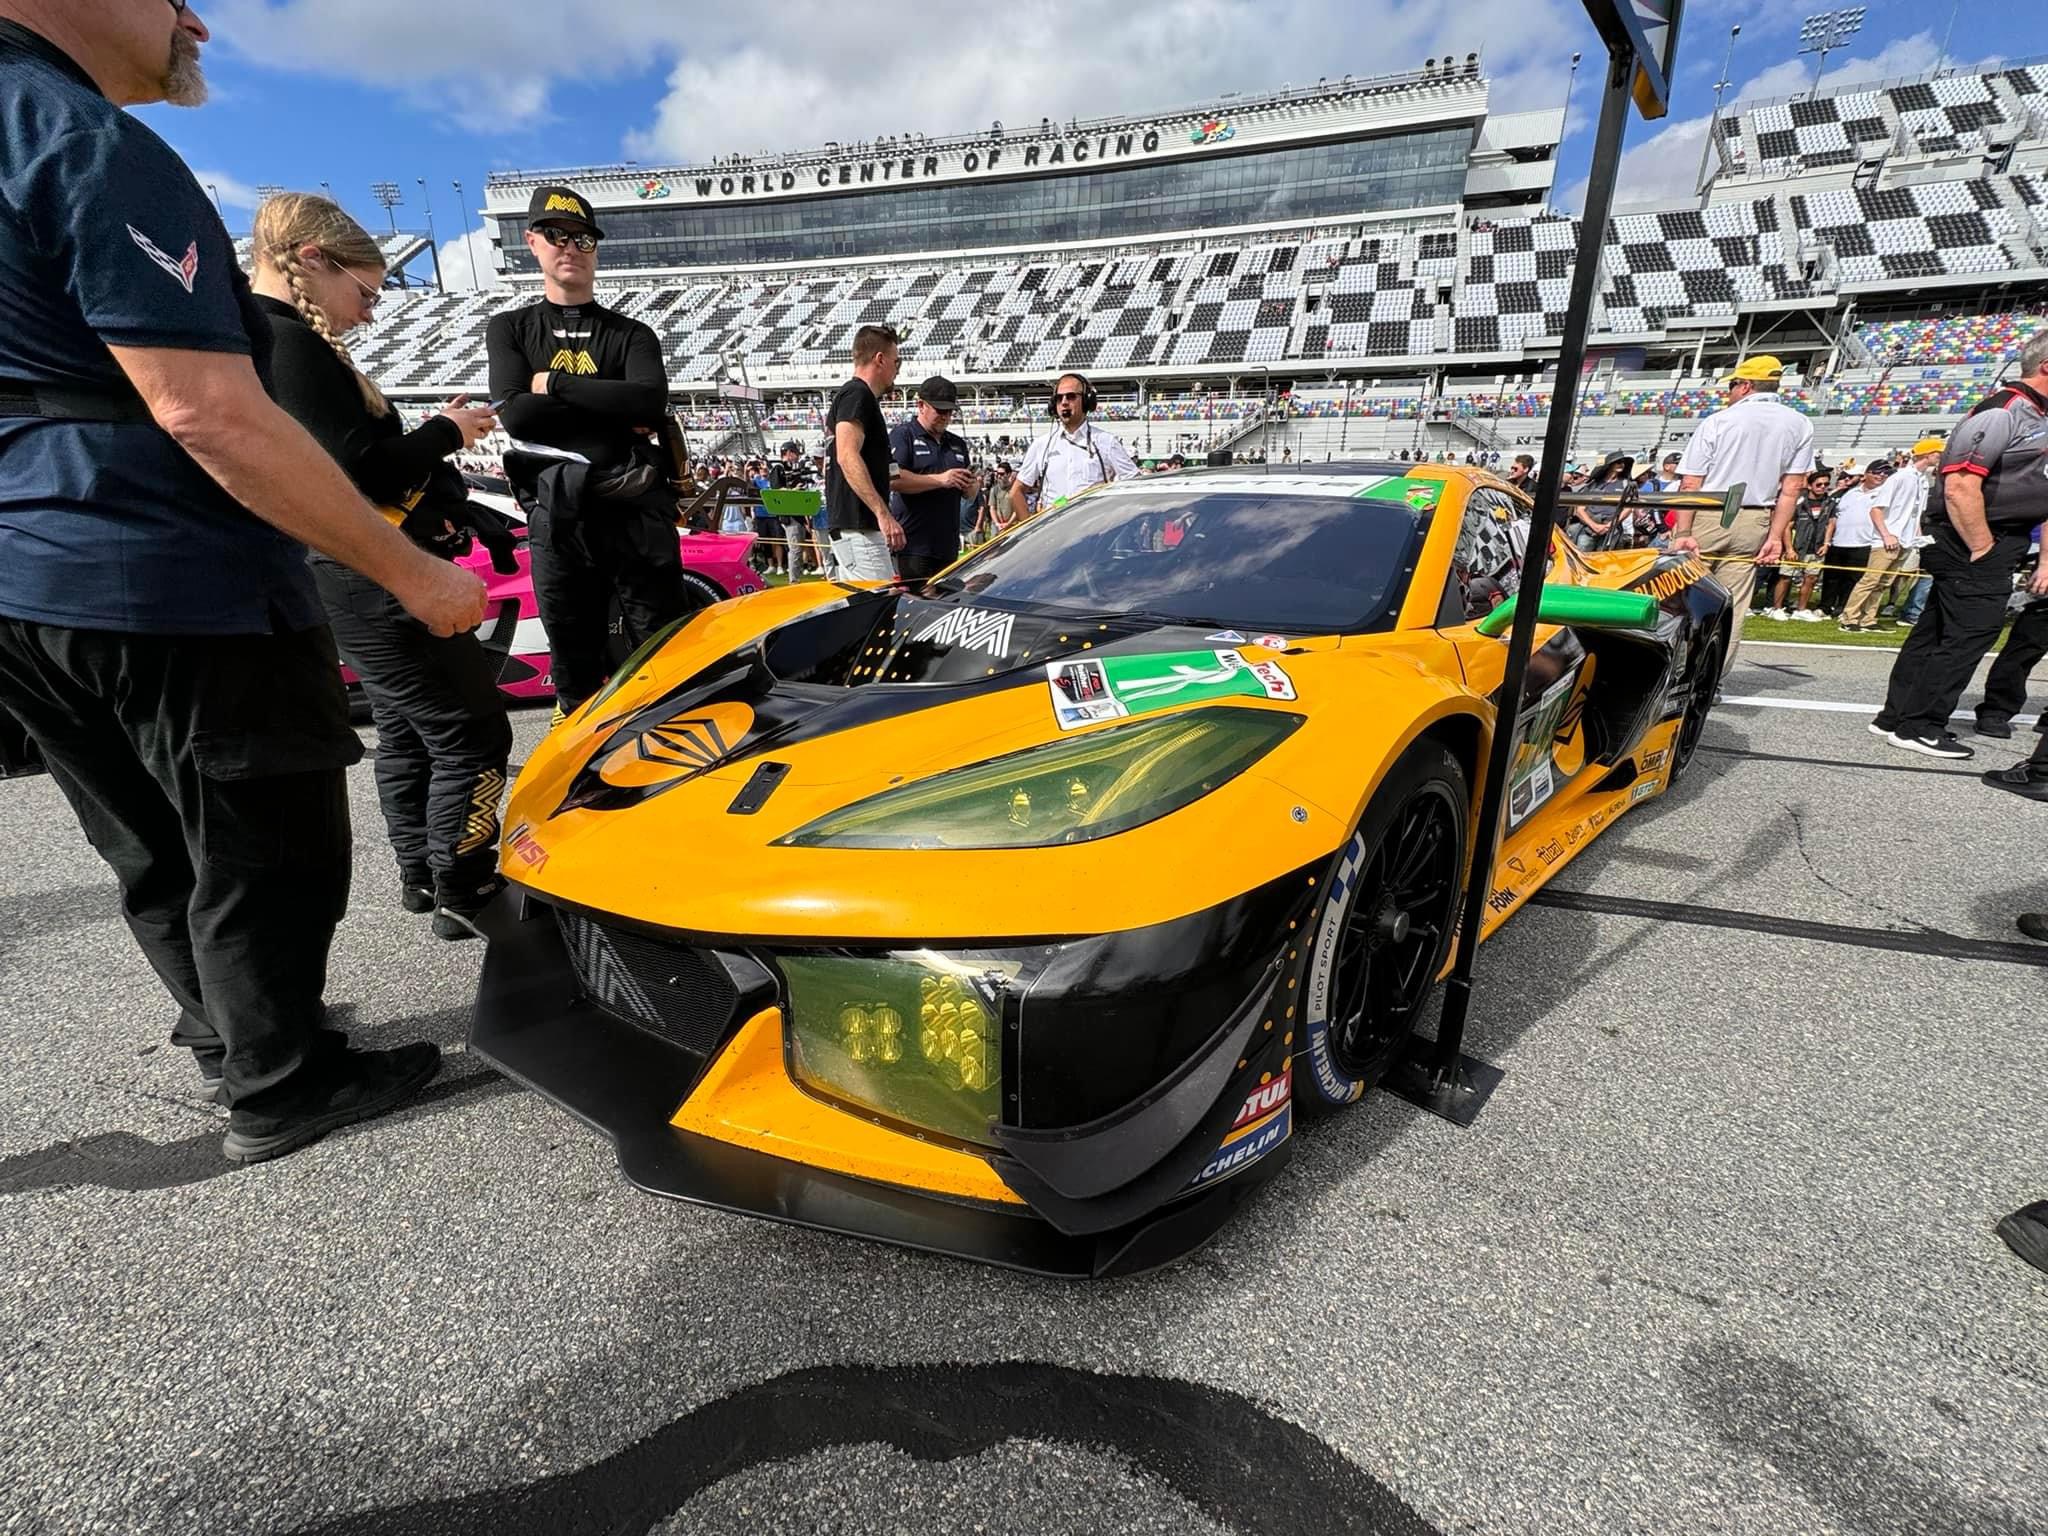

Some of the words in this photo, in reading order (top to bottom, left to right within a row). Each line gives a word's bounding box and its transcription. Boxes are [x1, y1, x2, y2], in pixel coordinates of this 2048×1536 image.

[695, 171, 796, 197] WORLD
[817, 157, 939, 187] CENTER
[963, 149, 1001, 173] OF
[1024, 131, 1160, 166] RACING
[1314, 974, 1325, 1012] PILOT
[1320, 916, 1337, 968] SPORT
[1311, 1028, 1348, 1101] MICHELIN
